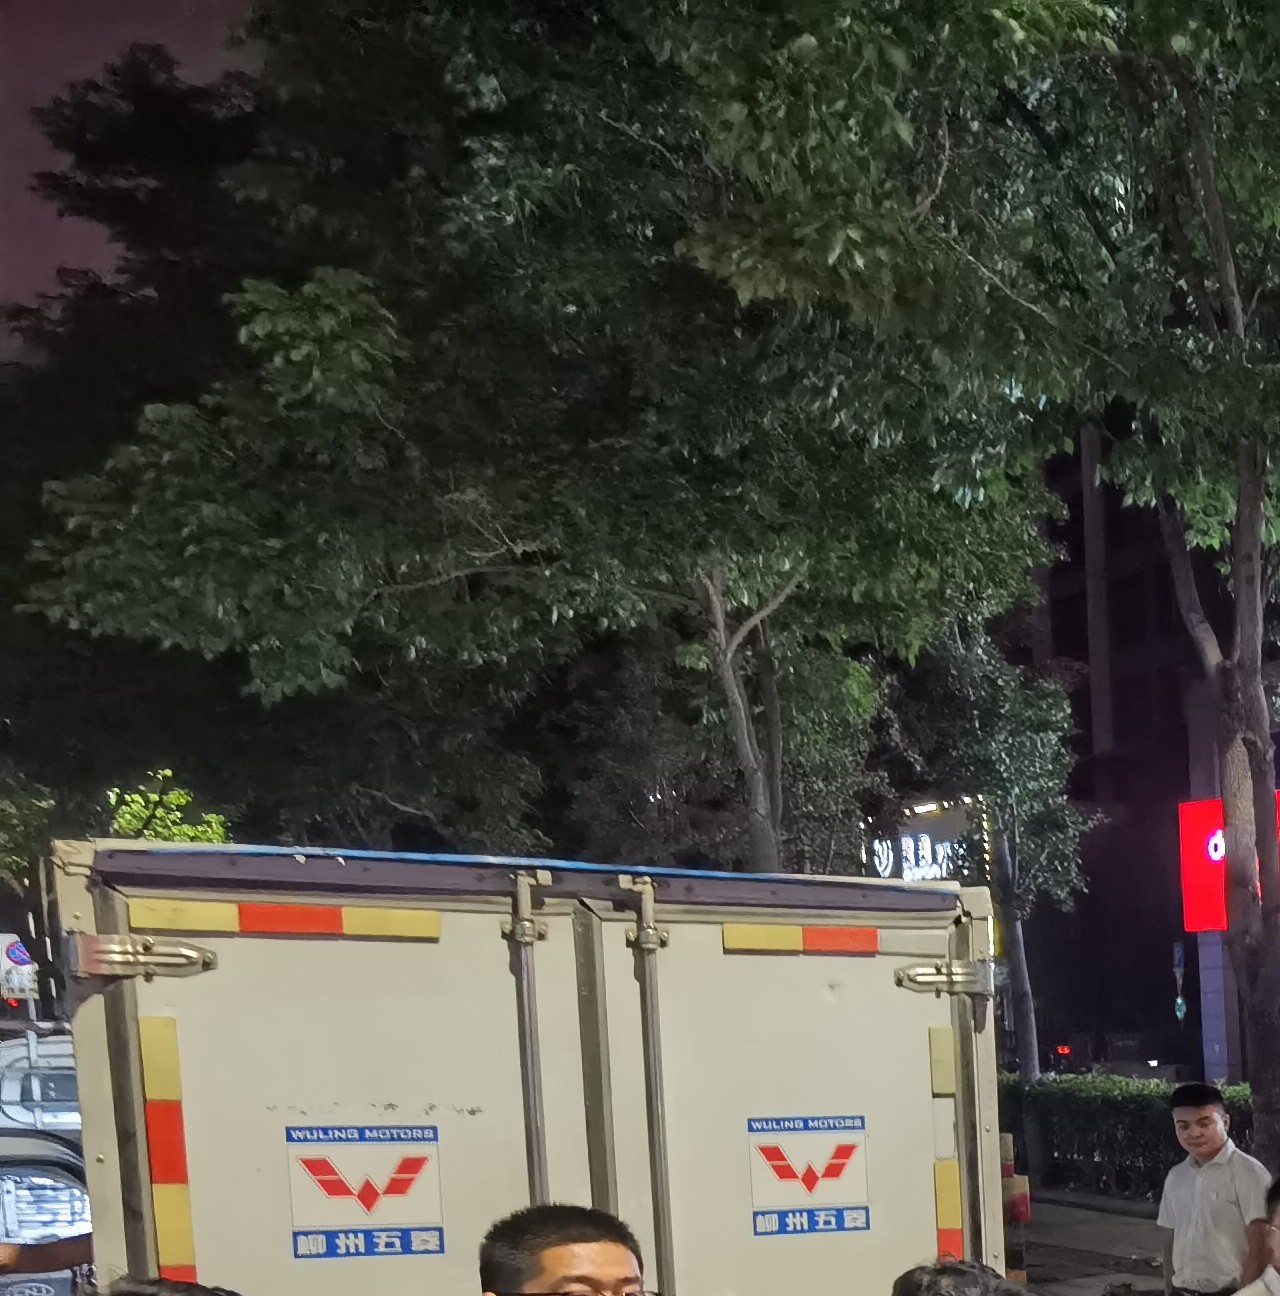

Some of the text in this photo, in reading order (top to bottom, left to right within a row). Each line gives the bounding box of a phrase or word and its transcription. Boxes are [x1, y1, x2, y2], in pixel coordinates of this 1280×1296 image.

[290, 1127, 434, 1141] WULING MOTORS
[750, 1118, 862, 1131] WULING MOTORS
[755, 1208, 867, 1233] 柳州五菱
[296, 1230, 442, 1256] 柳州五菱
